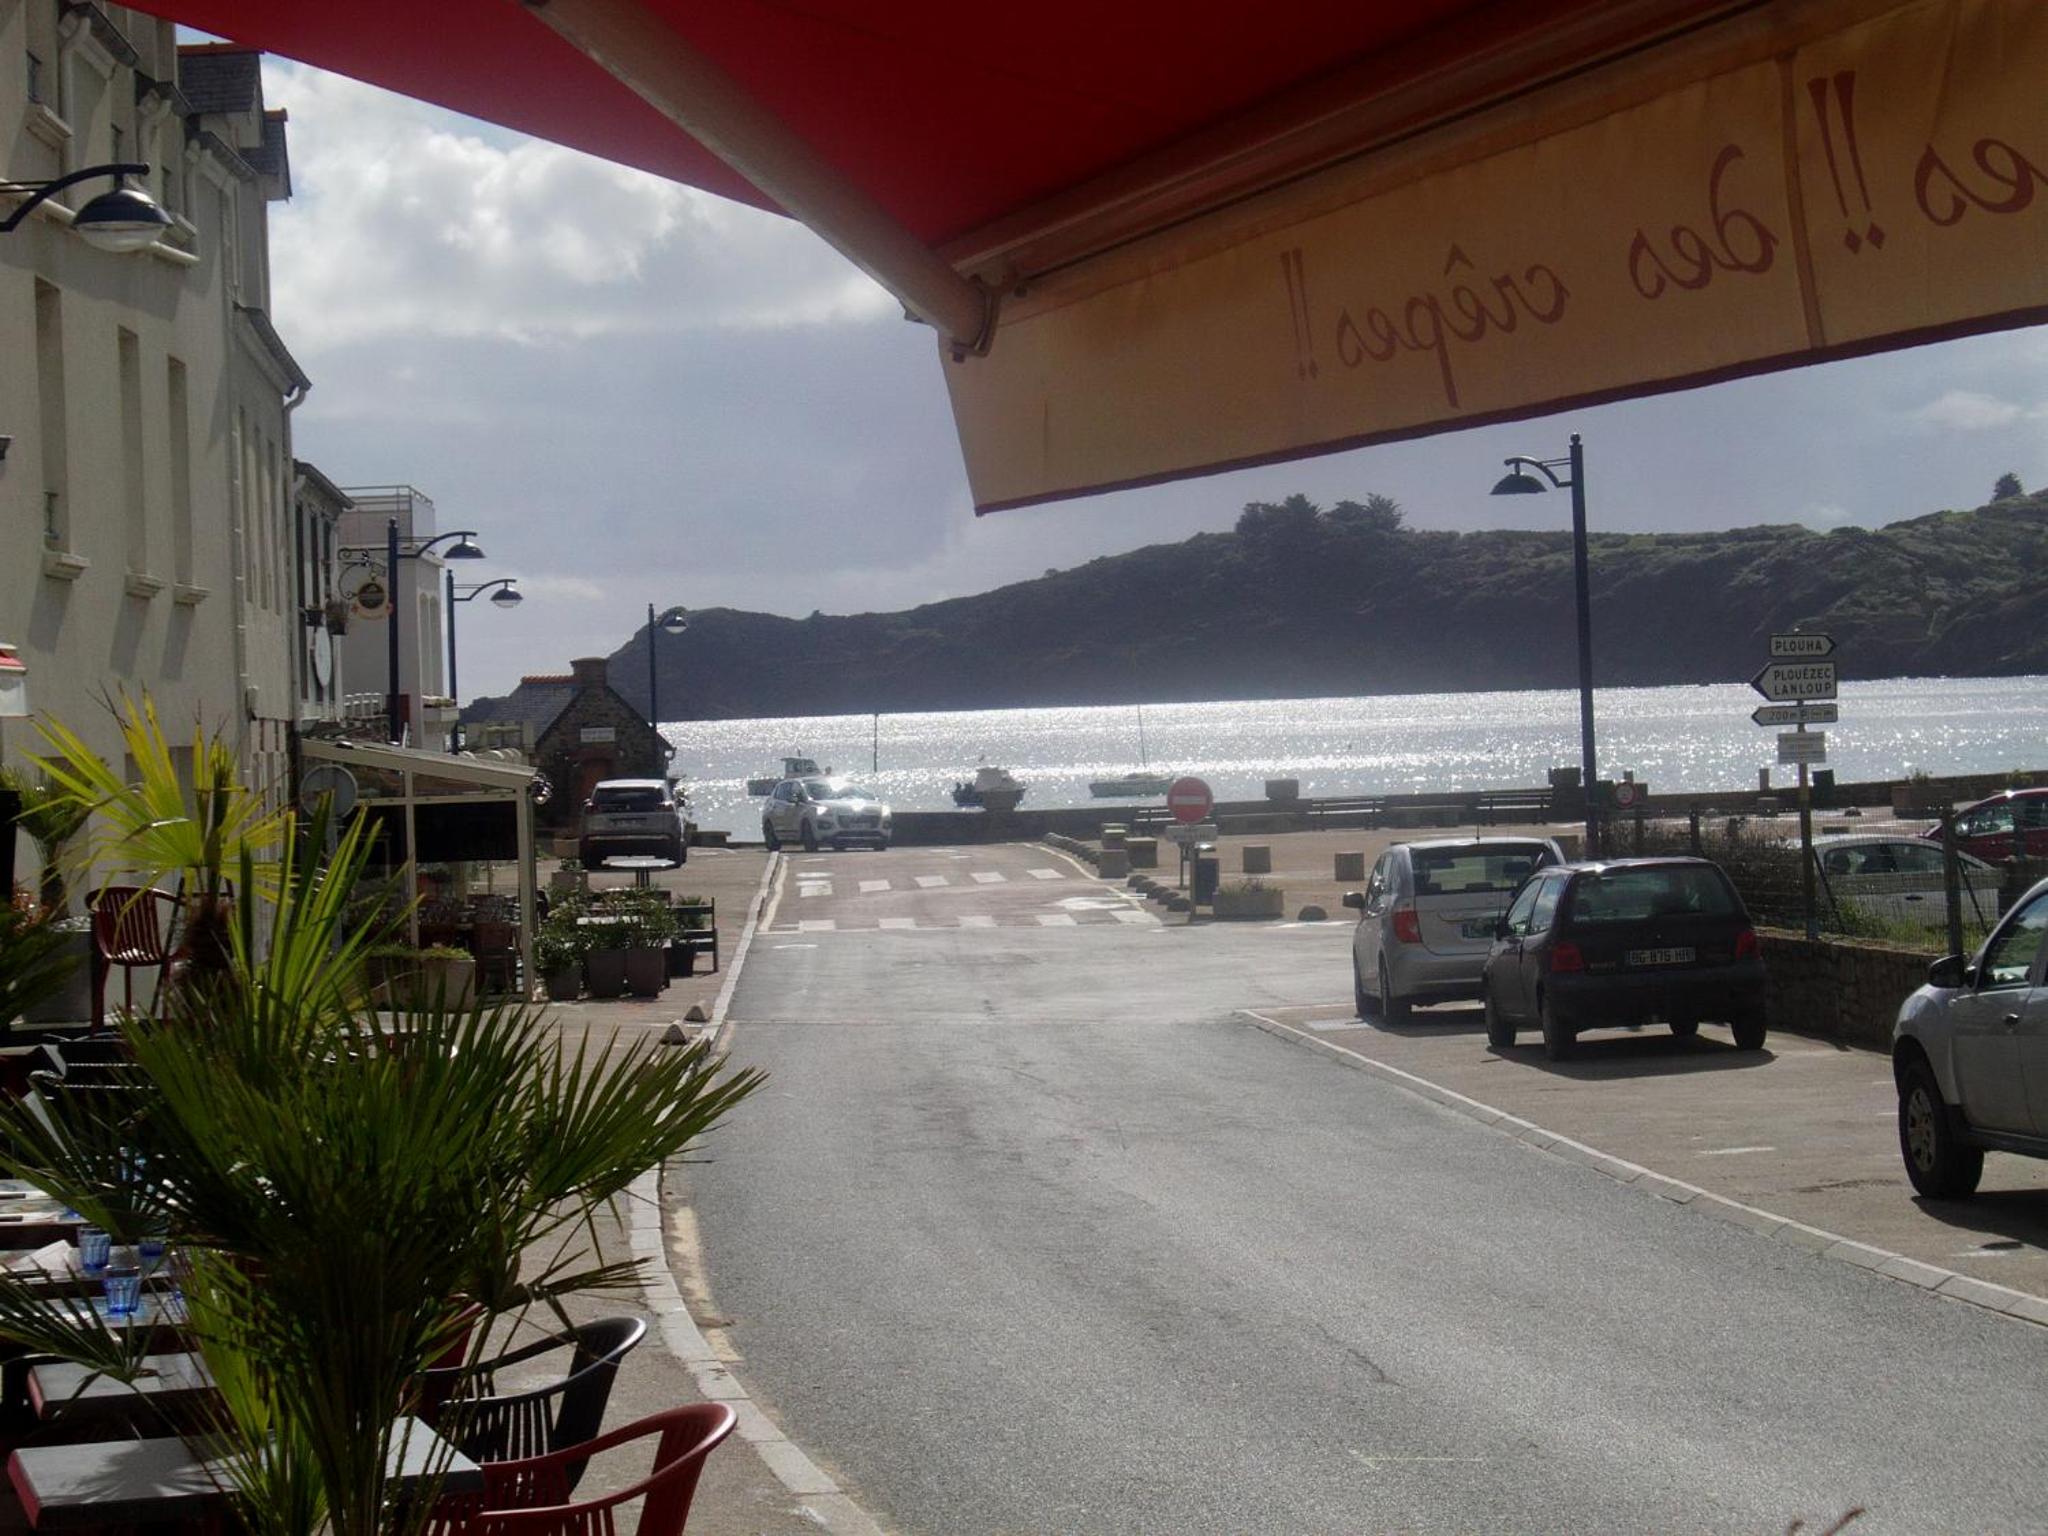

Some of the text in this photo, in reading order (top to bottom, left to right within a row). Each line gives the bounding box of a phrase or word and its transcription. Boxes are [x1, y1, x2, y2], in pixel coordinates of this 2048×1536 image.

[1774, 639, 1823, 652] PLOUHA
[1773, 667, 1832, 681] PLOUÉZEC
[1773, 682, 1832, 696] LANLOUP
